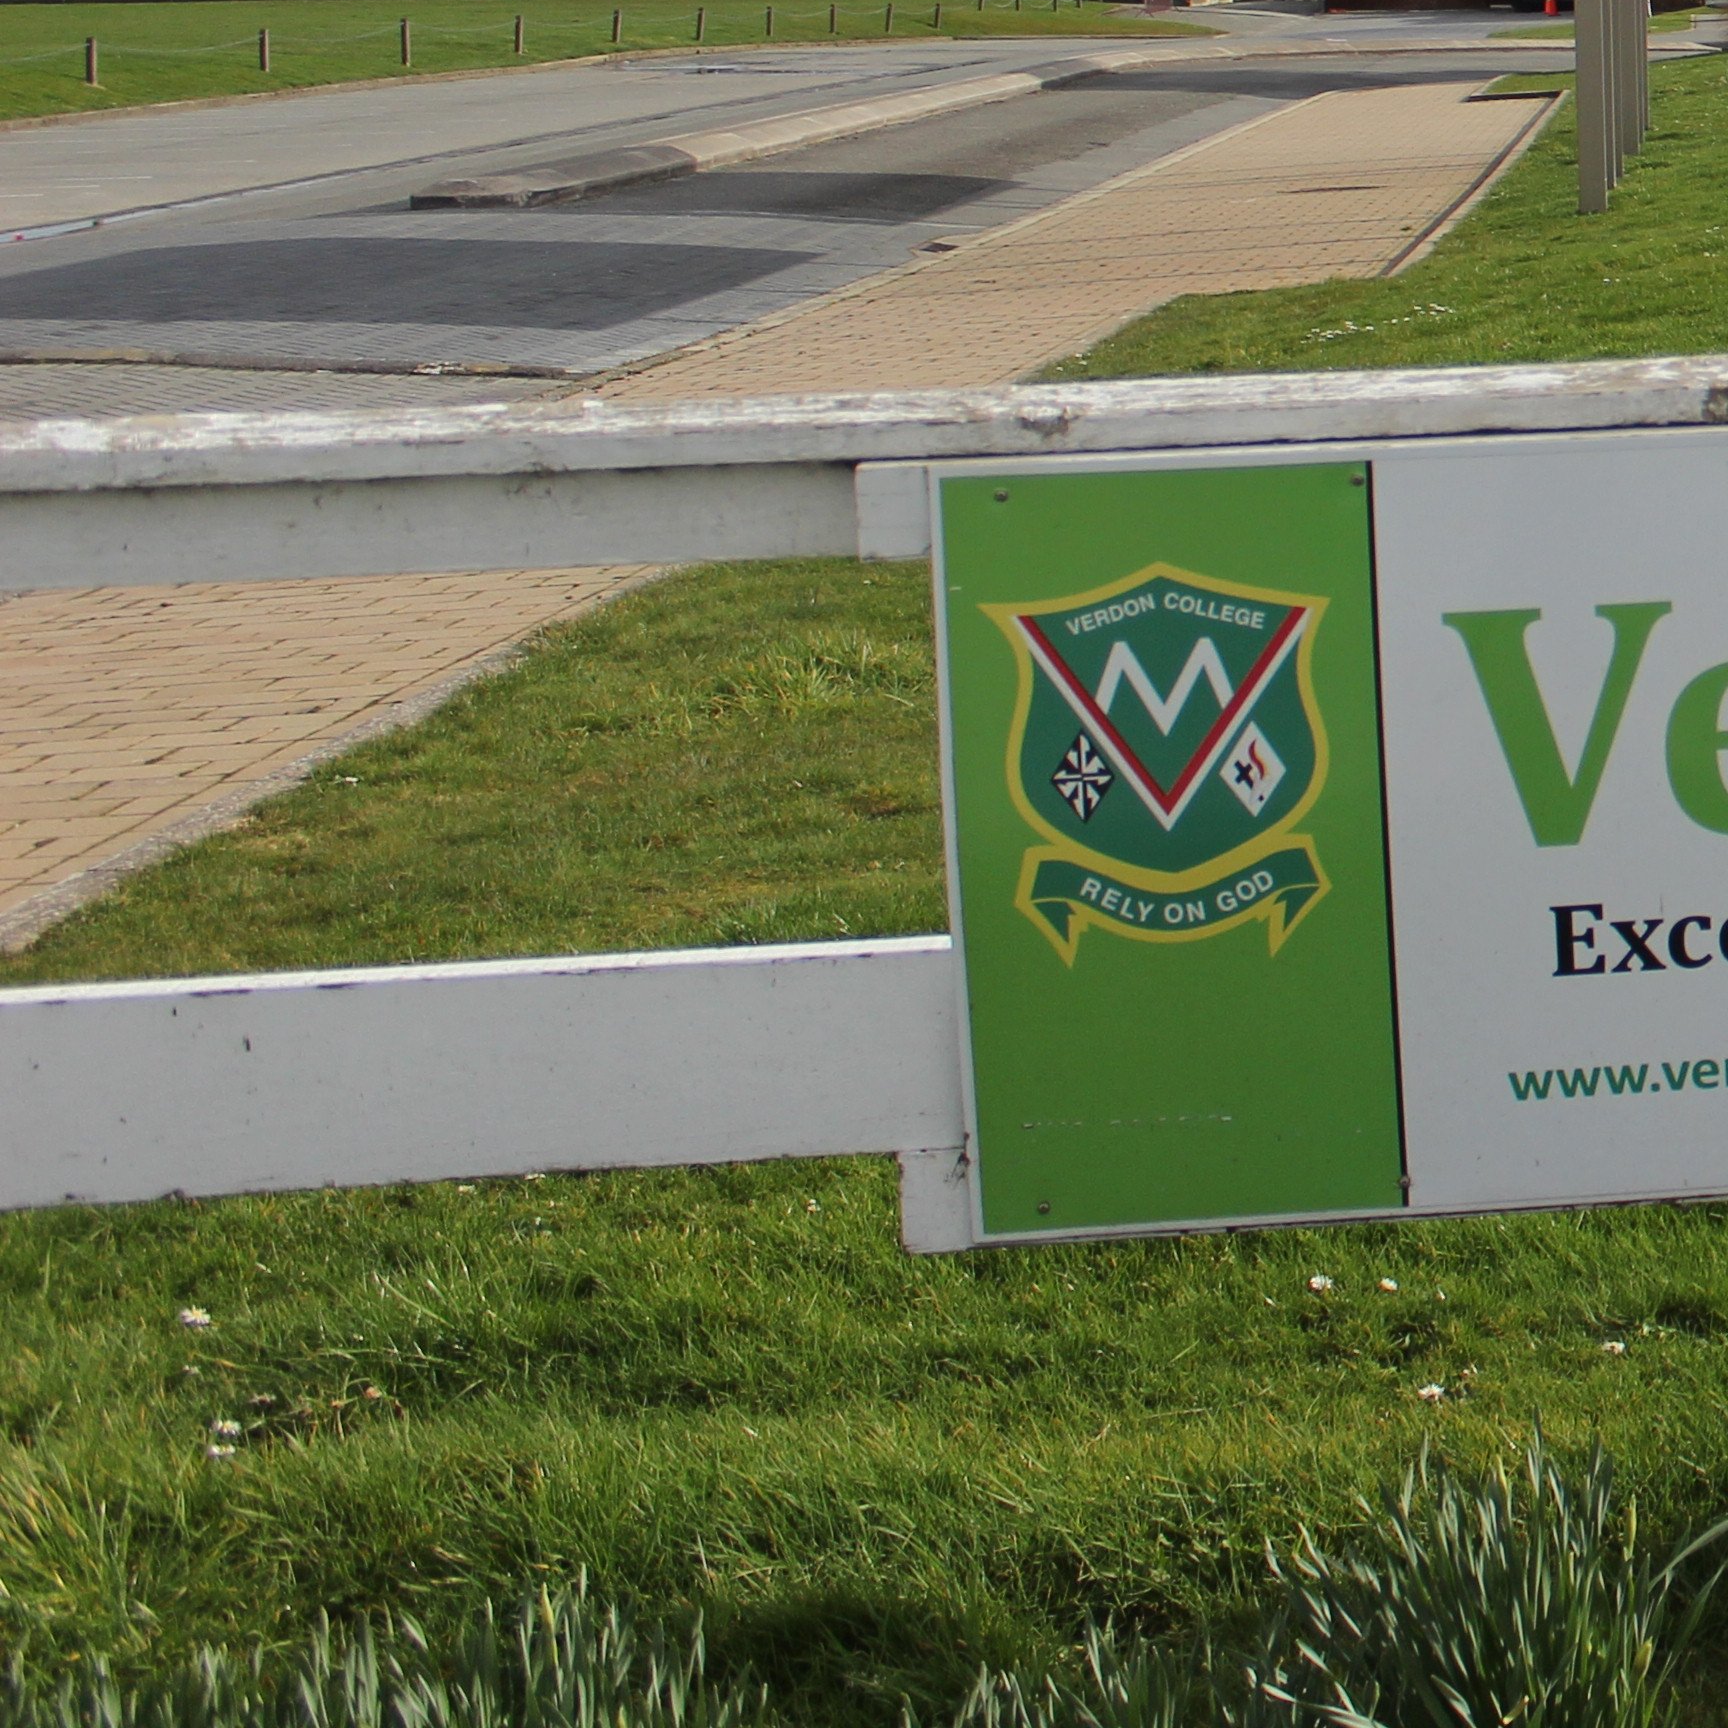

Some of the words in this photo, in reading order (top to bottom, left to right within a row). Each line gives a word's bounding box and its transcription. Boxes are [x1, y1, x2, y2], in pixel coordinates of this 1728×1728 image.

[1066, 594, 1155, 635] VERDON
[1164, 592, 1265, 629] COLLEGE
[1080, 878, 1153, 922] RELY
[1164, 901, 1205, 924] ON
[1216, 871, 1273, 912] GOD
